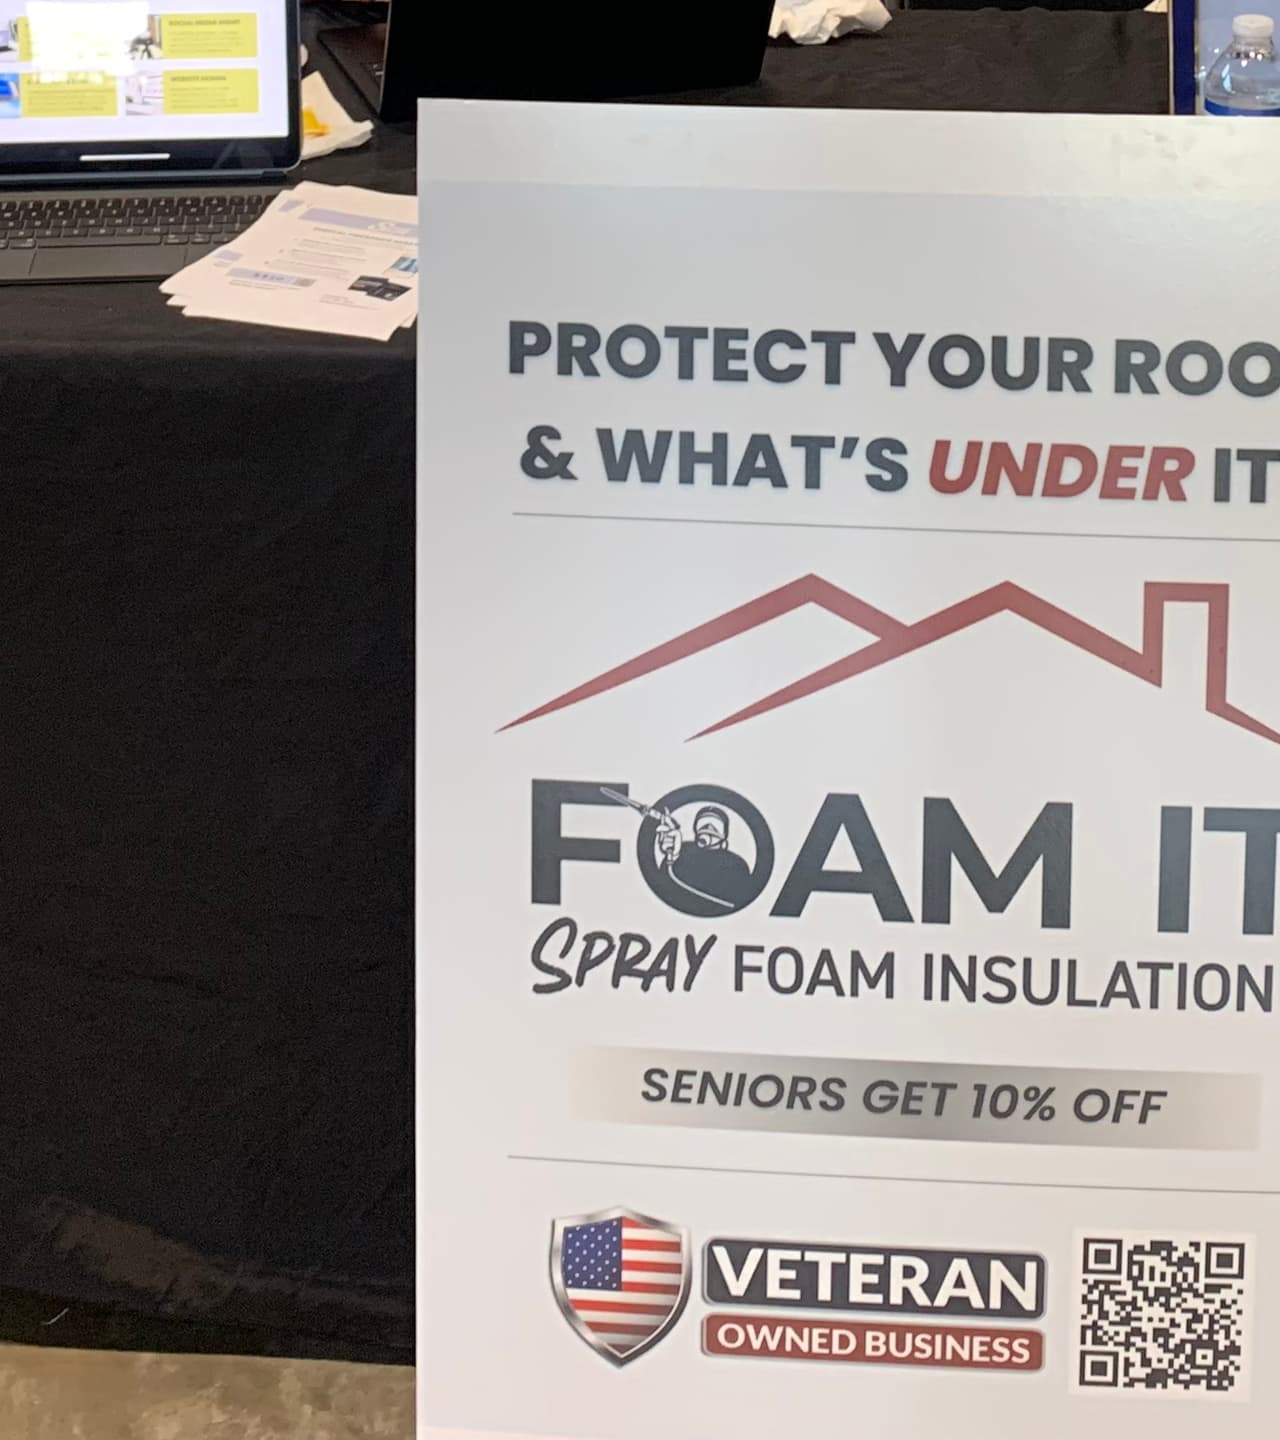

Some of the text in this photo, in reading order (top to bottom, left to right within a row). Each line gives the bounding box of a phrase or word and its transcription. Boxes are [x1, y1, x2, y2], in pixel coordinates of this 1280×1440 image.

[509, 320, 856, 386] PROTECT
[872, 332, 1094, 393] YOUR
[520, 425, 578, 481] &
[596, 428, 908, 493] WHAT'S
[929, 439, 1195, 502] UNDER
[531, 778, 1073, 930] FOAM
[531, 917, 1273, 1012] SPRAY FOAM INSULATION
[641, 1068, 1168, 1124] SENIORS GET 10% OFF
[712, 1246, 1039, 1313] VETERAN
[718, 1323, 1030, 1363] OWNED BUSINESS
